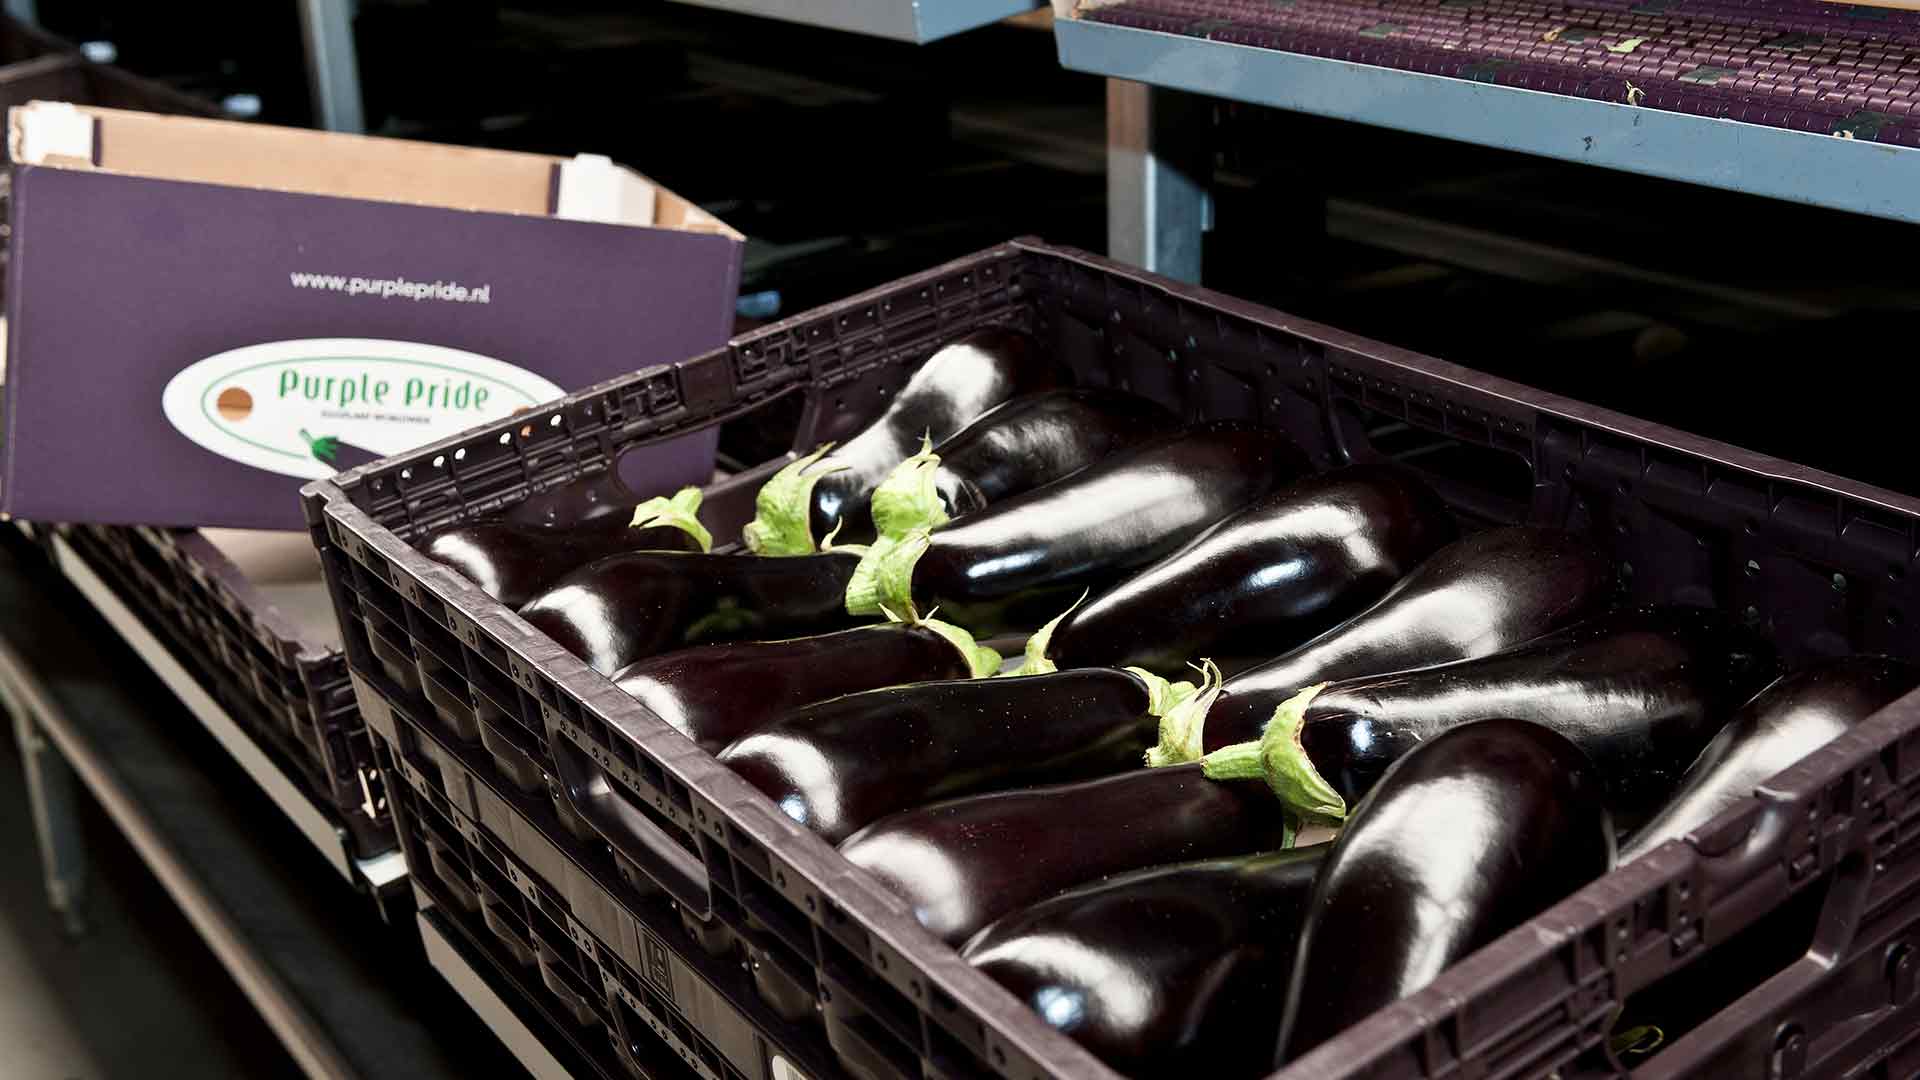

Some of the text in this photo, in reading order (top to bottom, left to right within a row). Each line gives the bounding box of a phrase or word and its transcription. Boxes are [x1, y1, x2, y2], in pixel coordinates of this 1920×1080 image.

[290, 271, 490, 303] www.purplepride.nl
[279, 369, 489, 411] Purple Pride
